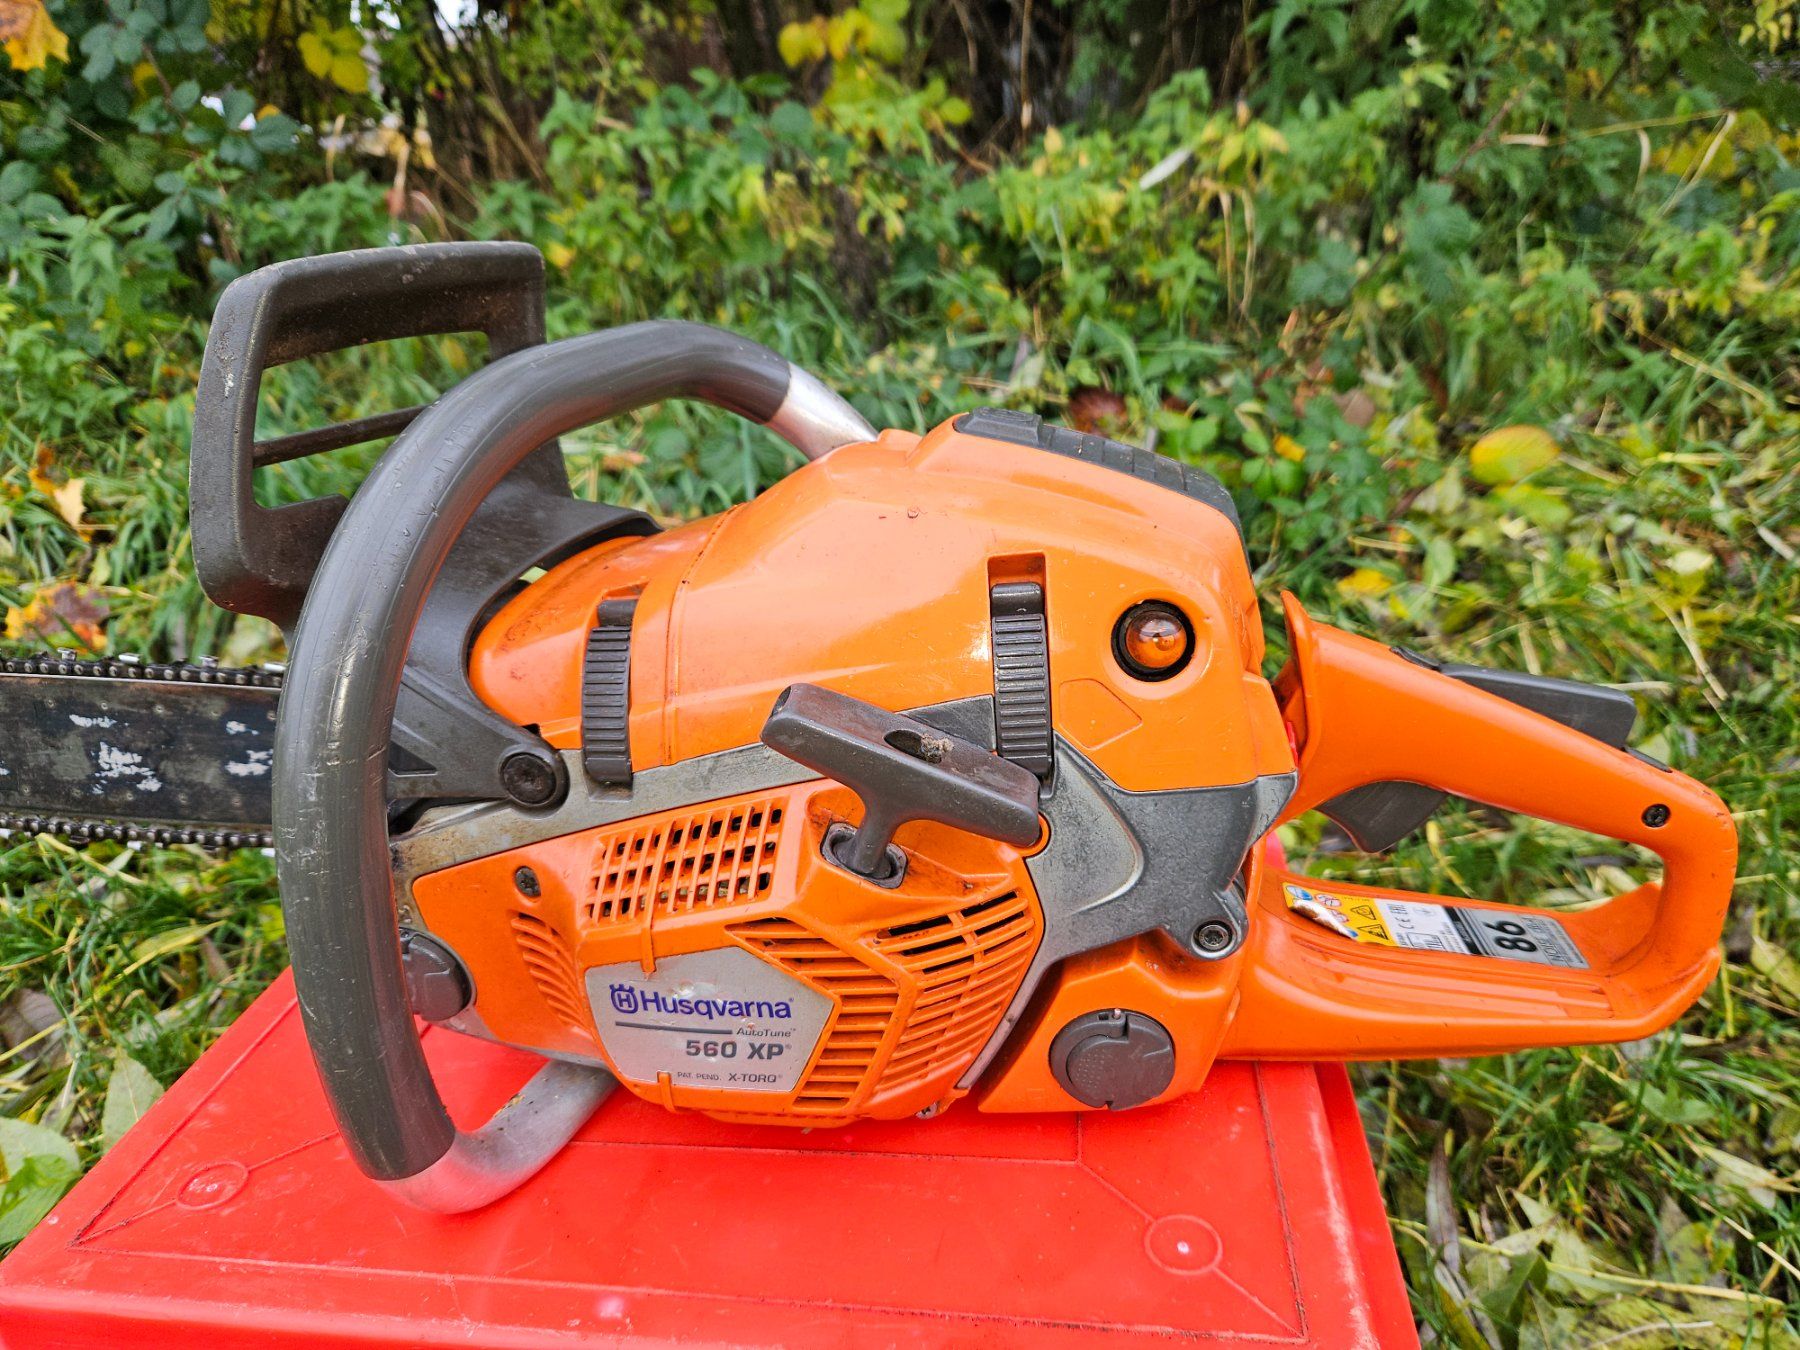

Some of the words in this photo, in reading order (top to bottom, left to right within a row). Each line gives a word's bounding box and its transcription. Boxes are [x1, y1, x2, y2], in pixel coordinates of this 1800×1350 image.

[640, 990, 792, 1020] Husqvarna
[686, 1040, 738, 1059] 560
[747, 1042, 784, 1060] XP
